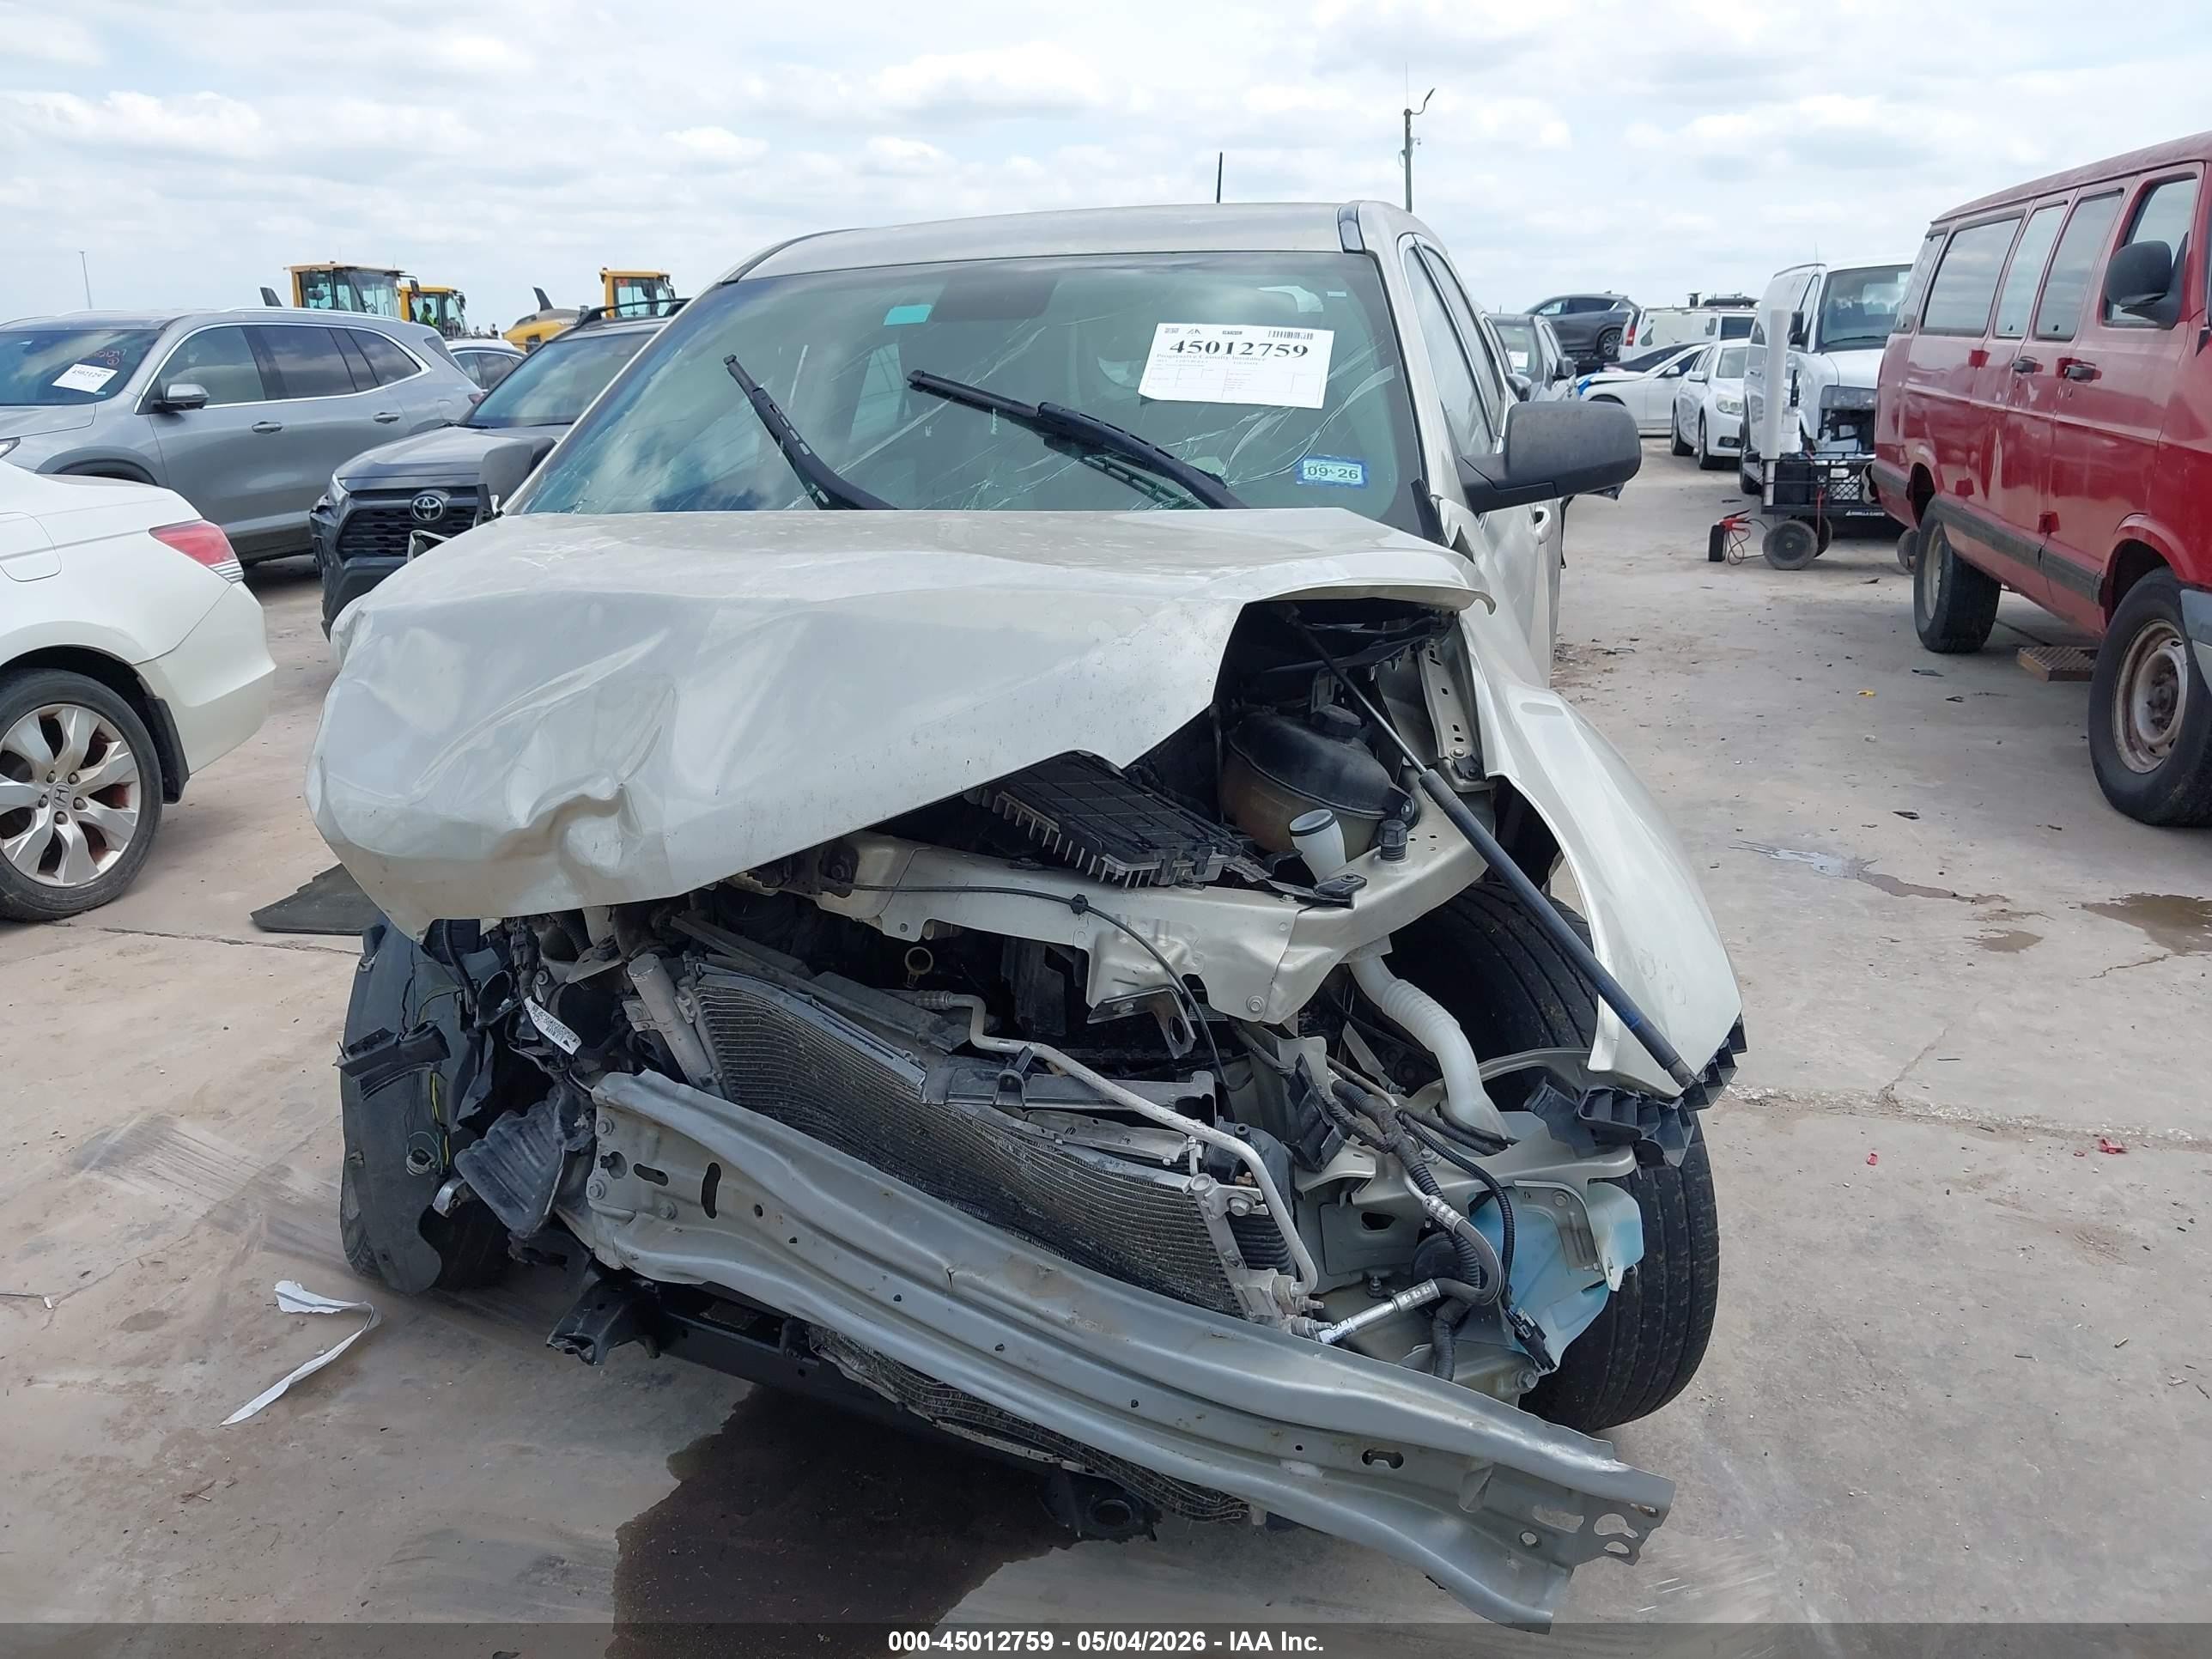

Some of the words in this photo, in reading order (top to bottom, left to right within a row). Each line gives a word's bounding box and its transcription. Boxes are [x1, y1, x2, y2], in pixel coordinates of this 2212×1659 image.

[1169, 339, 1309, 359] 45012759
[1308, 466, 1328, 477] 09
[1338, 468, 1358, 479] 26
